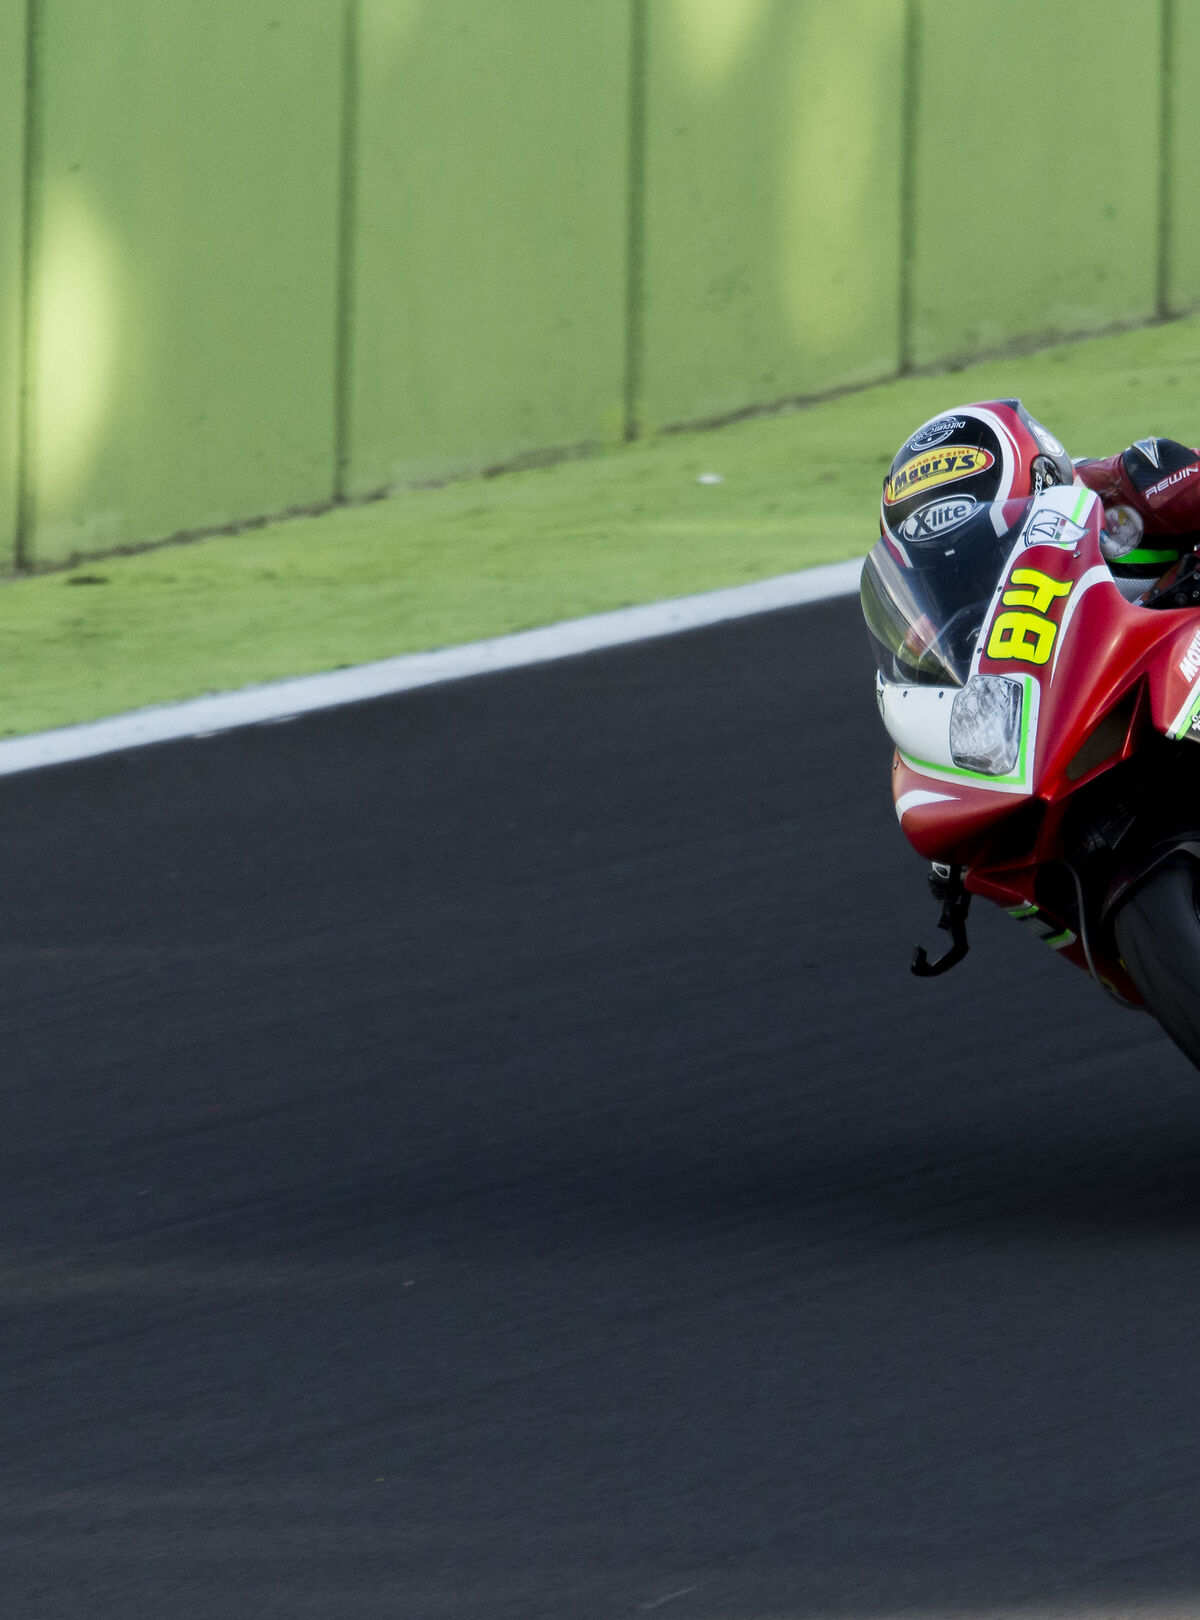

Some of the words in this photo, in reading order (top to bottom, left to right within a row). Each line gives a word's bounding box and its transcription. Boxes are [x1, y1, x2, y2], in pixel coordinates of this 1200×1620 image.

[1145, 465, 1199, 499] REWIN
[911, 503, 967, 540] X-lite
[986, 567, 1074, 666] 84
